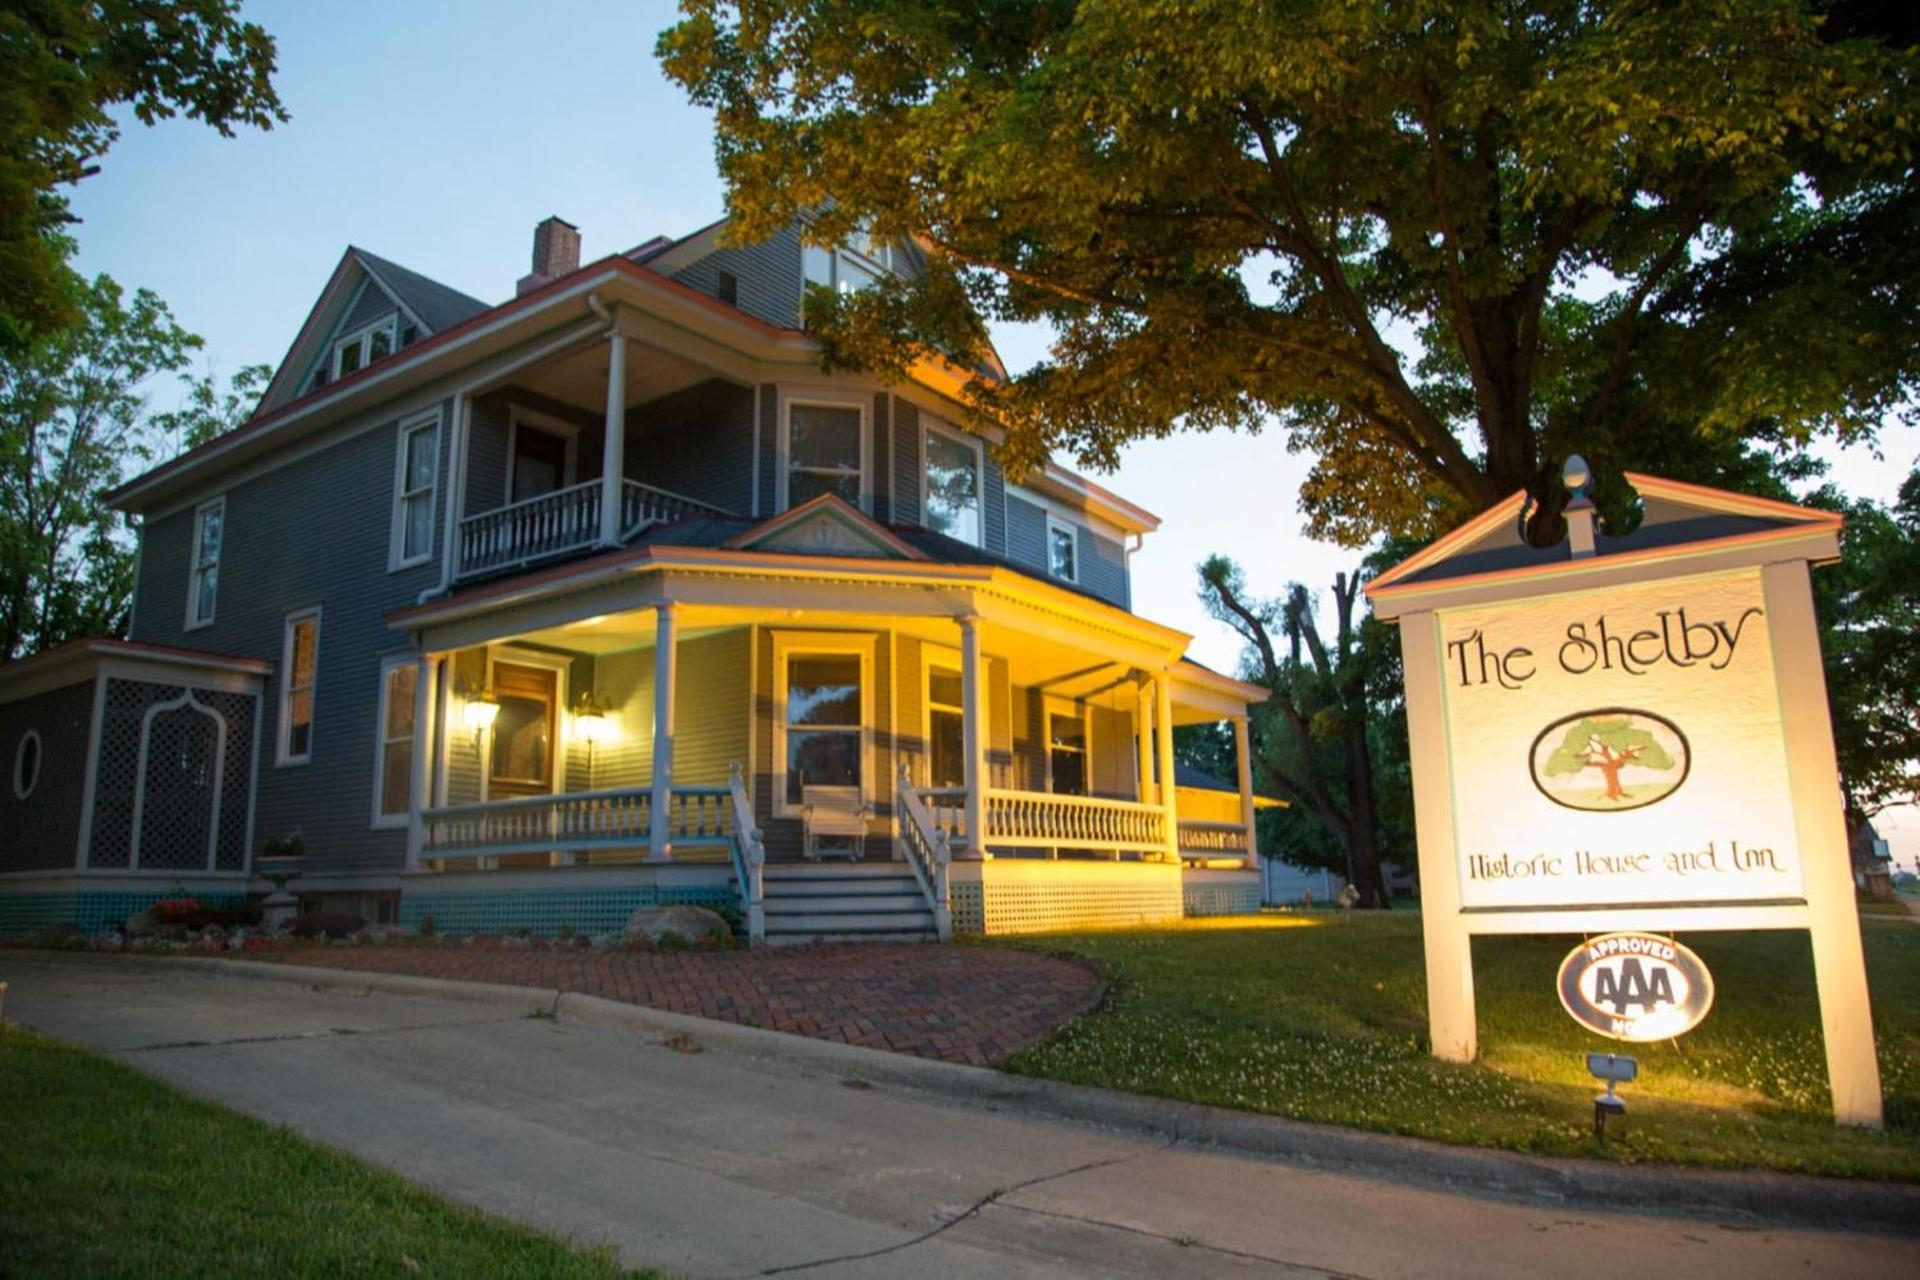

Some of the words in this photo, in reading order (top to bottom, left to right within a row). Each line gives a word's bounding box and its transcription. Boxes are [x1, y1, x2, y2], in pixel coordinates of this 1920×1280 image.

[1447, 629, 1537, 690] The
[1559, 606, 1764, 676] Shelby
[1469, 852, 1564, 881] Historic
[1575, 850, 1651, 877] House
[1664, 842, 1722, 876] and
[1730, 840, 1787, 874] Inn
[1590, 937, 1675, 961] APPROVED
[1594, 958, 1675, 1015] AAA
